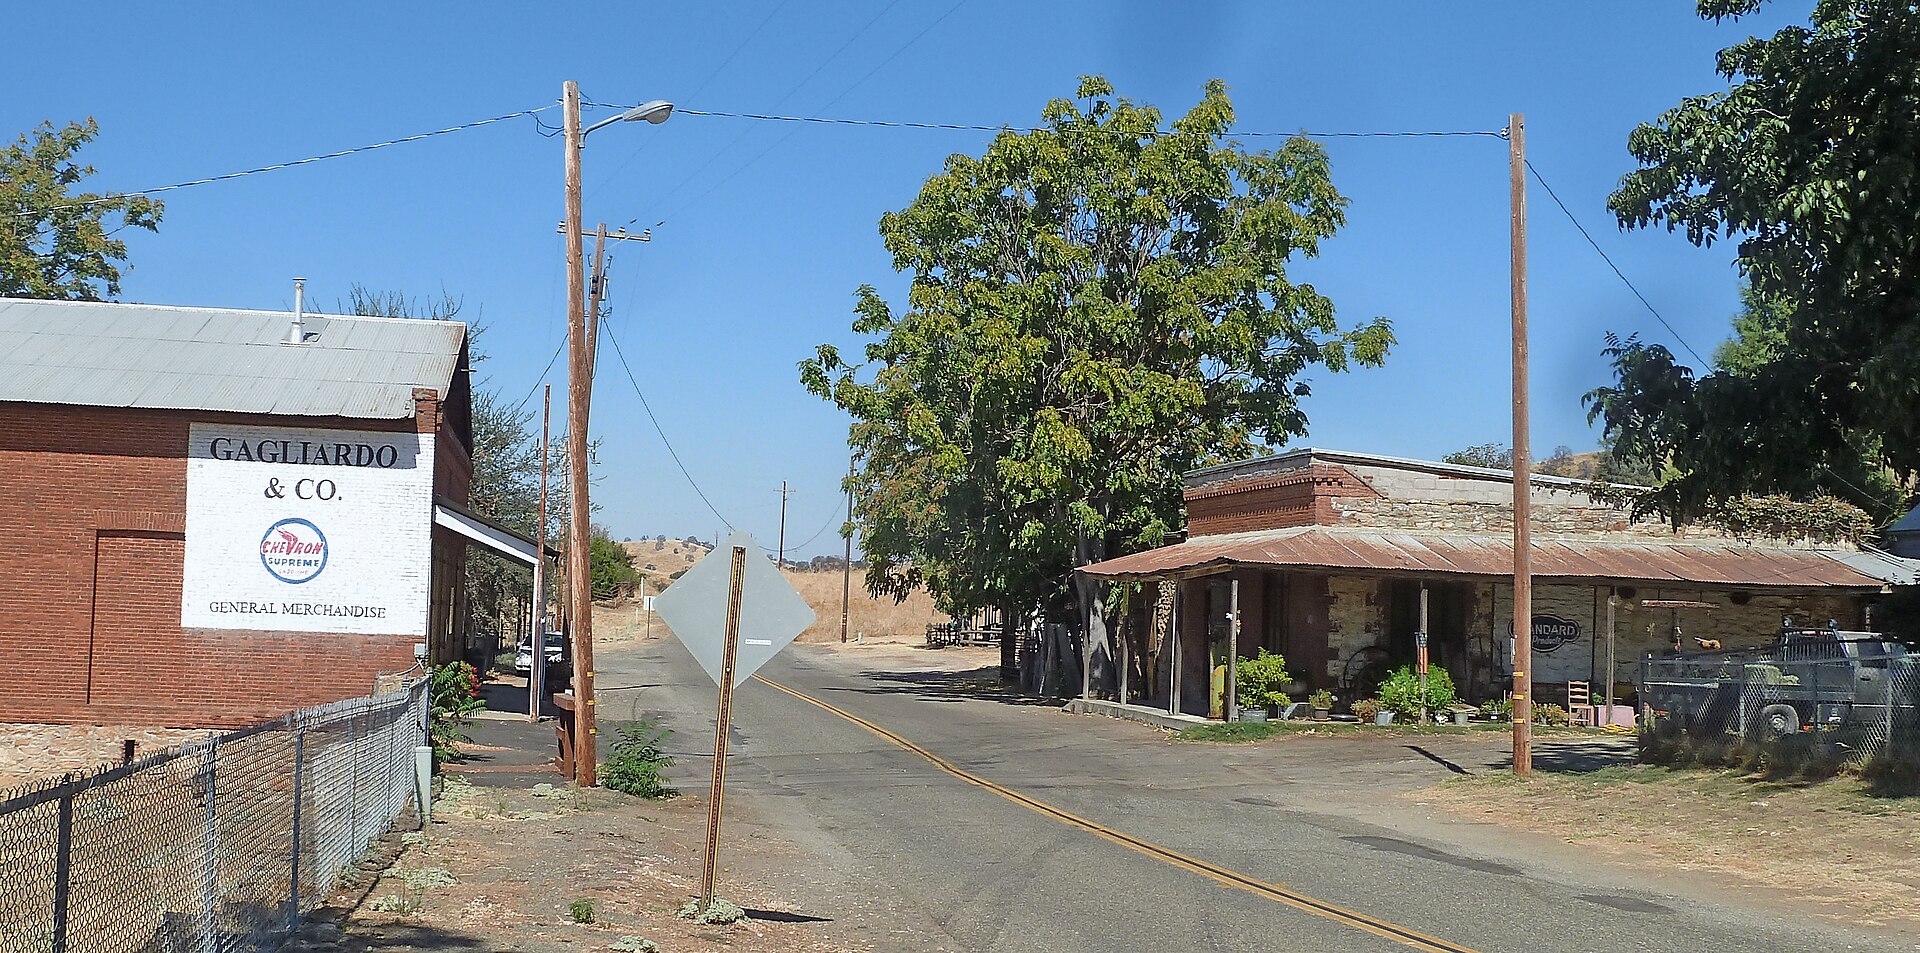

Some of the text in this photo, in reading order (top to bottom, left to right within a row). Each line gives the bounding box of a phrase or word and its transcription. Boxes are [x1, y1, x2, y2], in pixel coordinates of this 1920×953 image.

[210, 437, 398, 468] GAGLIARDO
[264, 477, 342, 500] & CO.
[262, 535, 324, 555] CHEVRON
[268, 557, 320, 567] SUPREME
[210, 601, 386, 618] GENERAL MERCHANDISE
